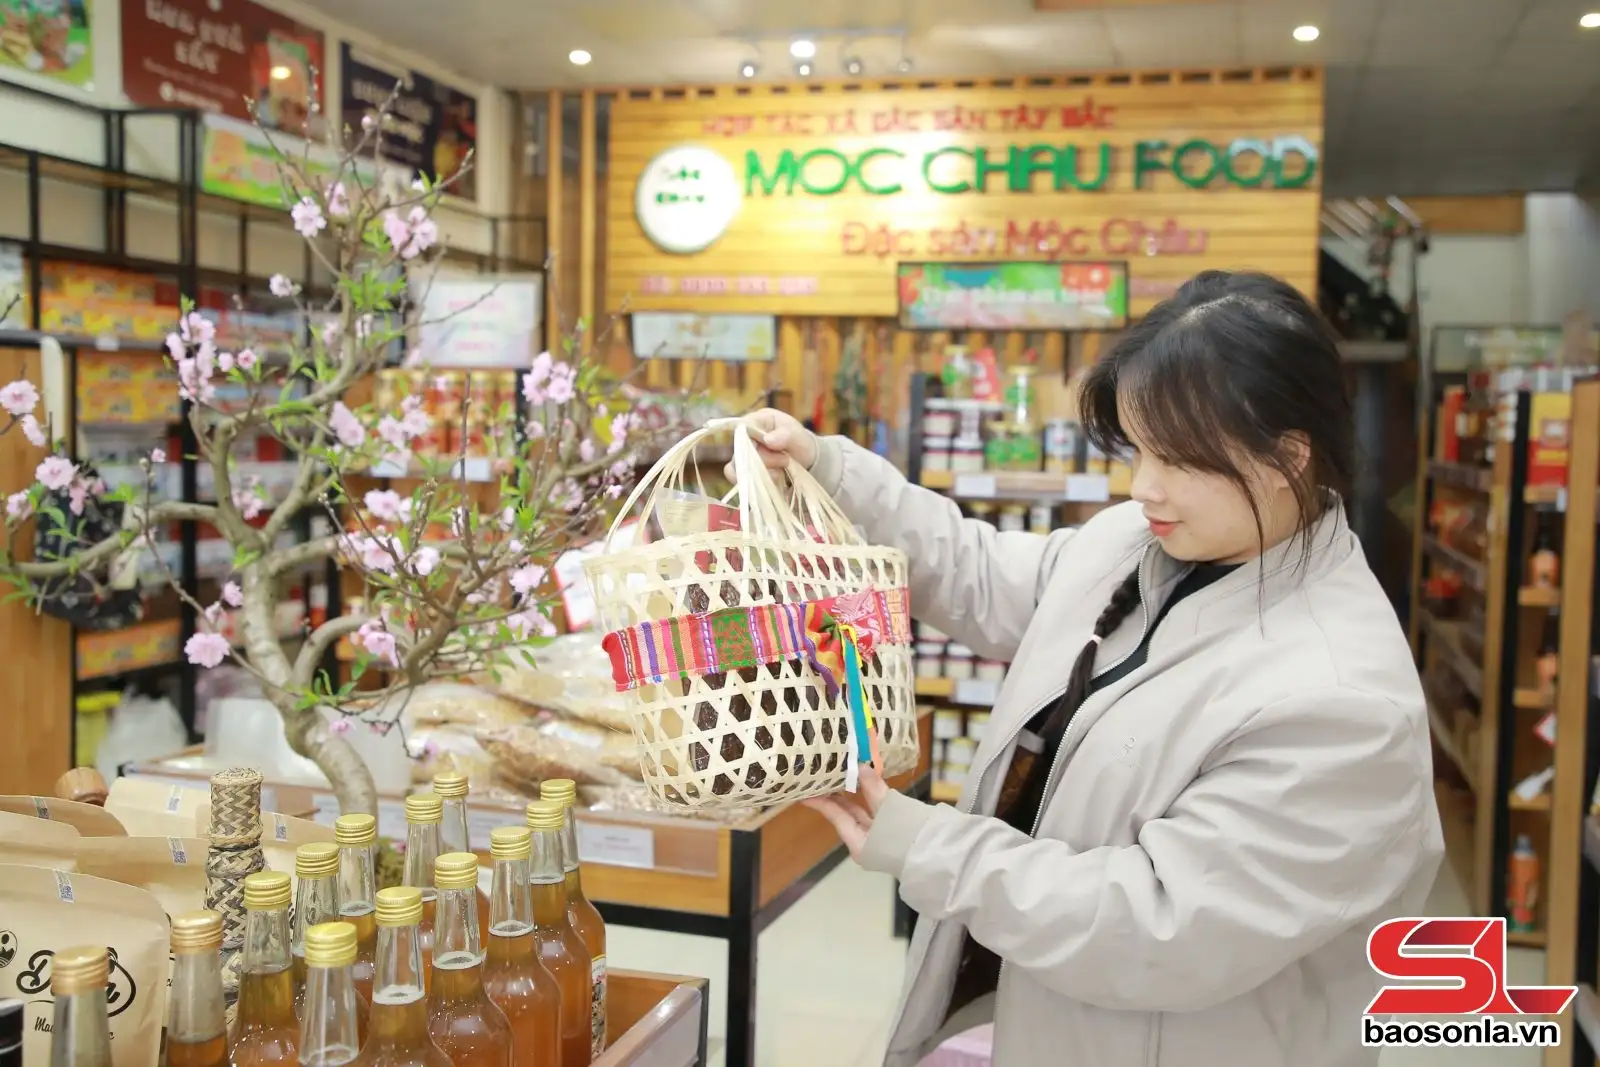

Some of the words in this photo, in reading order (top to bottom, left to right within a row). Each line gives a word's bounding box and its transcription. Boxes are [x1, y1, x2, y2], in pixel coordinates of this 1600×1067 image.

[1000, 102, 1049, 130] TÂY
[1062, 95, 1117, 128] BẮC
[744, 147, 906, 197] MOC
[921, 141, 1111, 193] CHAU
[1134, 134, 1318, 191] FOOD
[840, 221, 917, 262] Đặc
[927, 219, 996, 256] sản
[1004, 218, 1090, 262] Mộc
[1101, 216, 1209, 257] Châu
